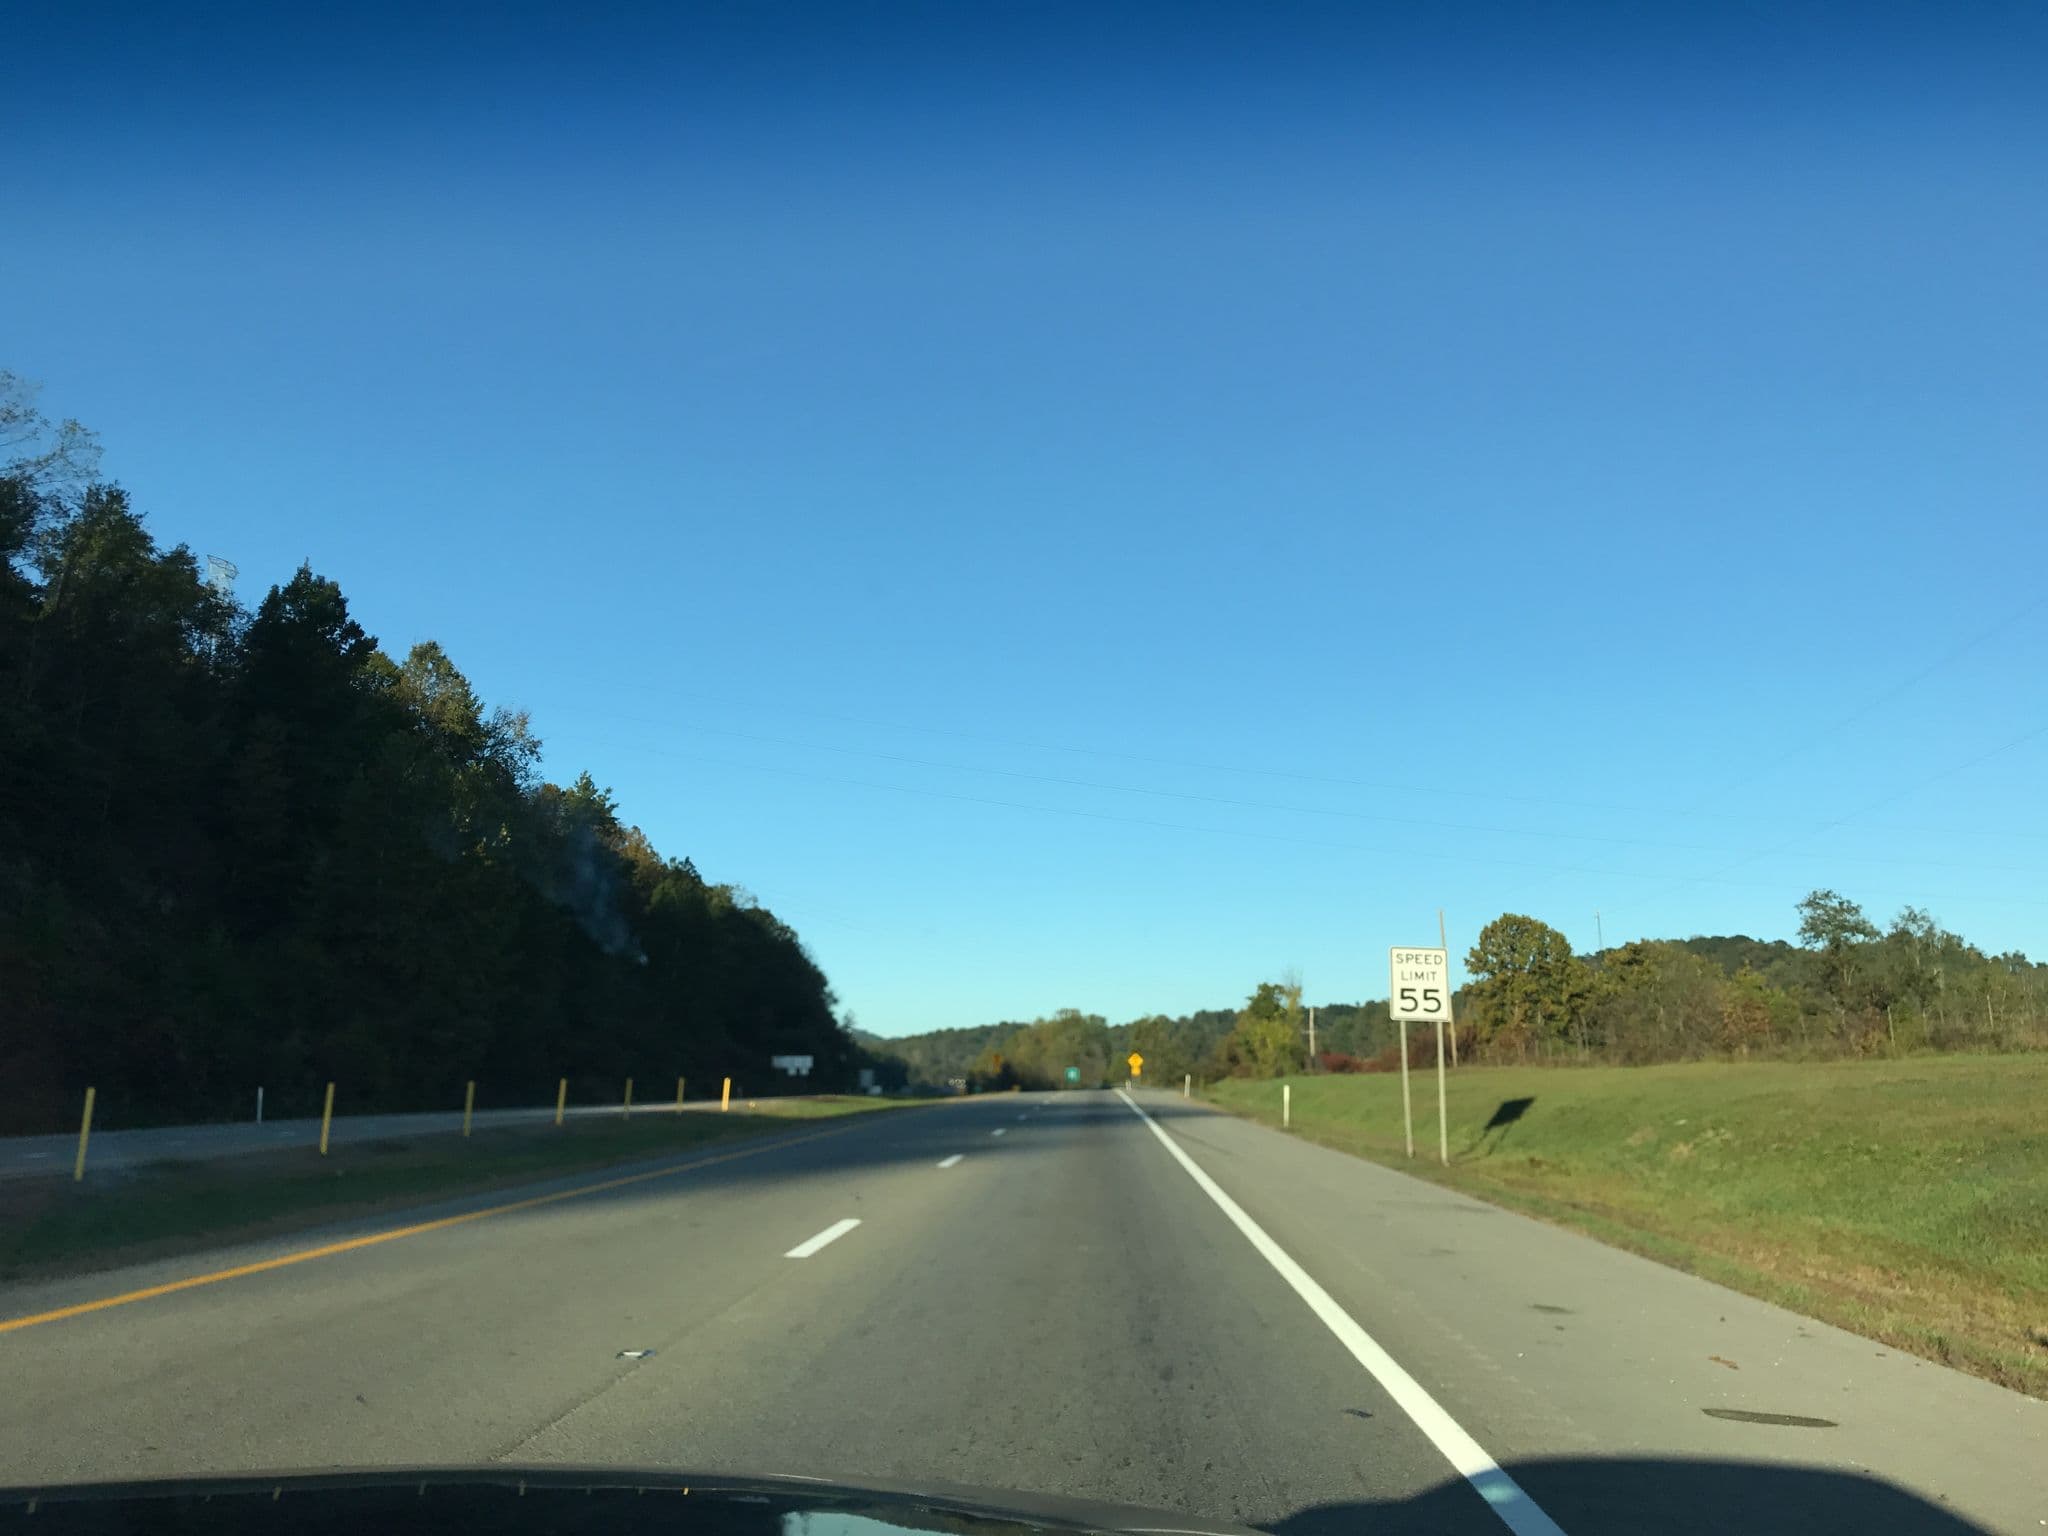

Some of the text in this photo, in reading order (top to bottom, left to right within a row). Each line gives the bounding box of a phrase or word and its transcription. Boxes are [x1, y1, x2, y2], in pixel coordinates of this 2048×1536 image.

[1396, 953, 1443, 965] SPEED
[1401, 970, 1437, 981] LIMIT
[1400, 988, 1442, 1013] 55
